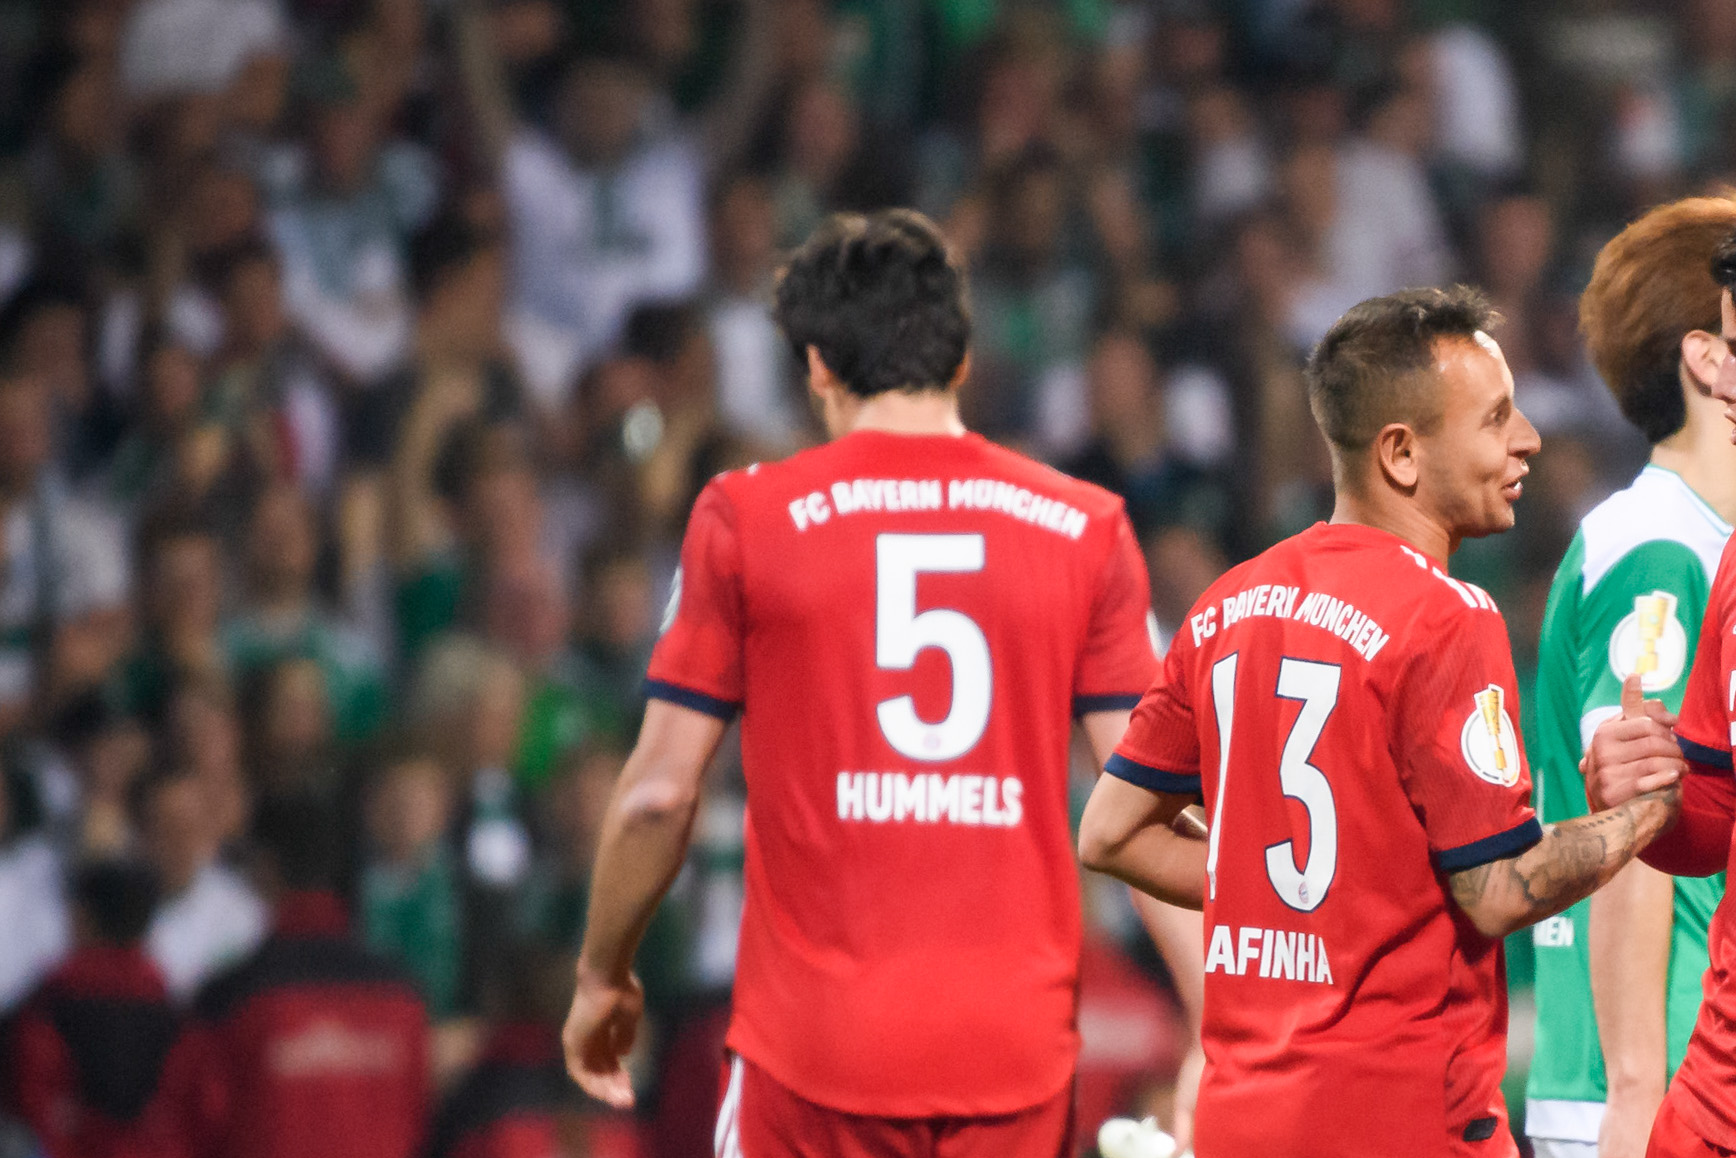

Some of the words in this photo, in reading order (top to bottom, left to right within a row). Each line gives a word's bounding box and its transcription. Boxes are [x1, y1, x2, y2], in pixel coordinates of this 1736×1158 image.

[788, 491, 831, 531] FC
[831, 478, 942, 516] BAYERN
[876, 533, 993, 762] 5
[1190, 606, 1217, 648] FC
[836, 771, 1025, 829] HUMMELS
[1206, 650, 1342, 913] 13
